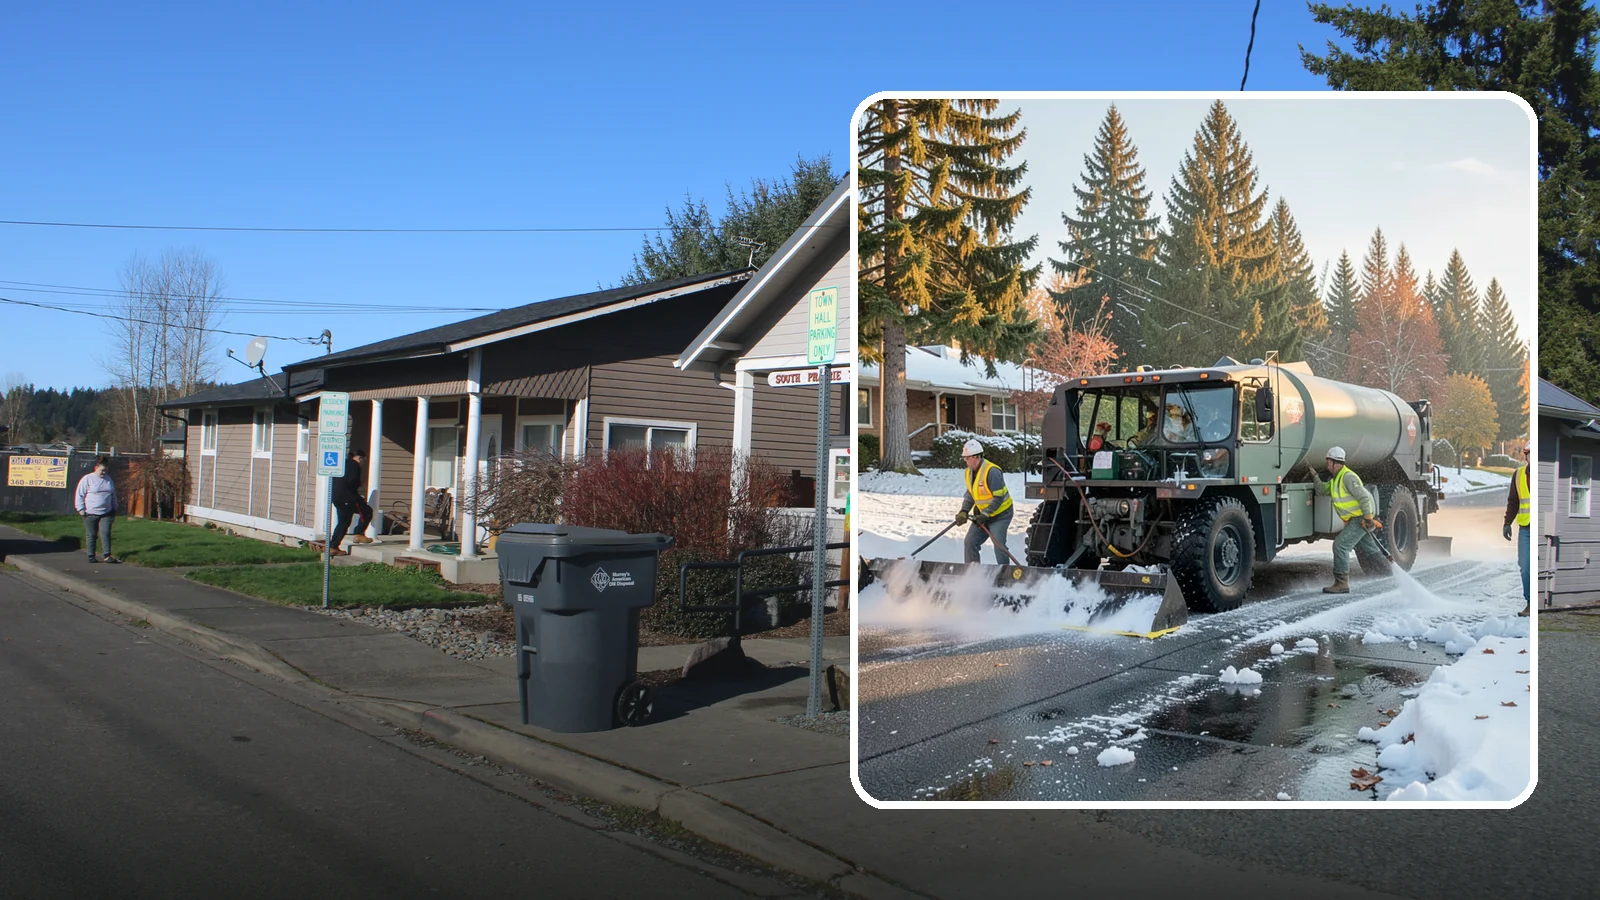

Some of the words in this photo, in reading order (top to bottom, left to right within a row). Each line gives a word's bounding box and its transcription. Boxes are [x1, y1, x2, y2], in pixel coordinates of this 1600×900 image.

[815, 295, 833, 308] TOWN
[814, 311, 831, 324] HALL
[810, 326, 835, 340] PARKING
[813, 344, 831, 357] ONLY
[775, 373, 801, 384] SOUTH
